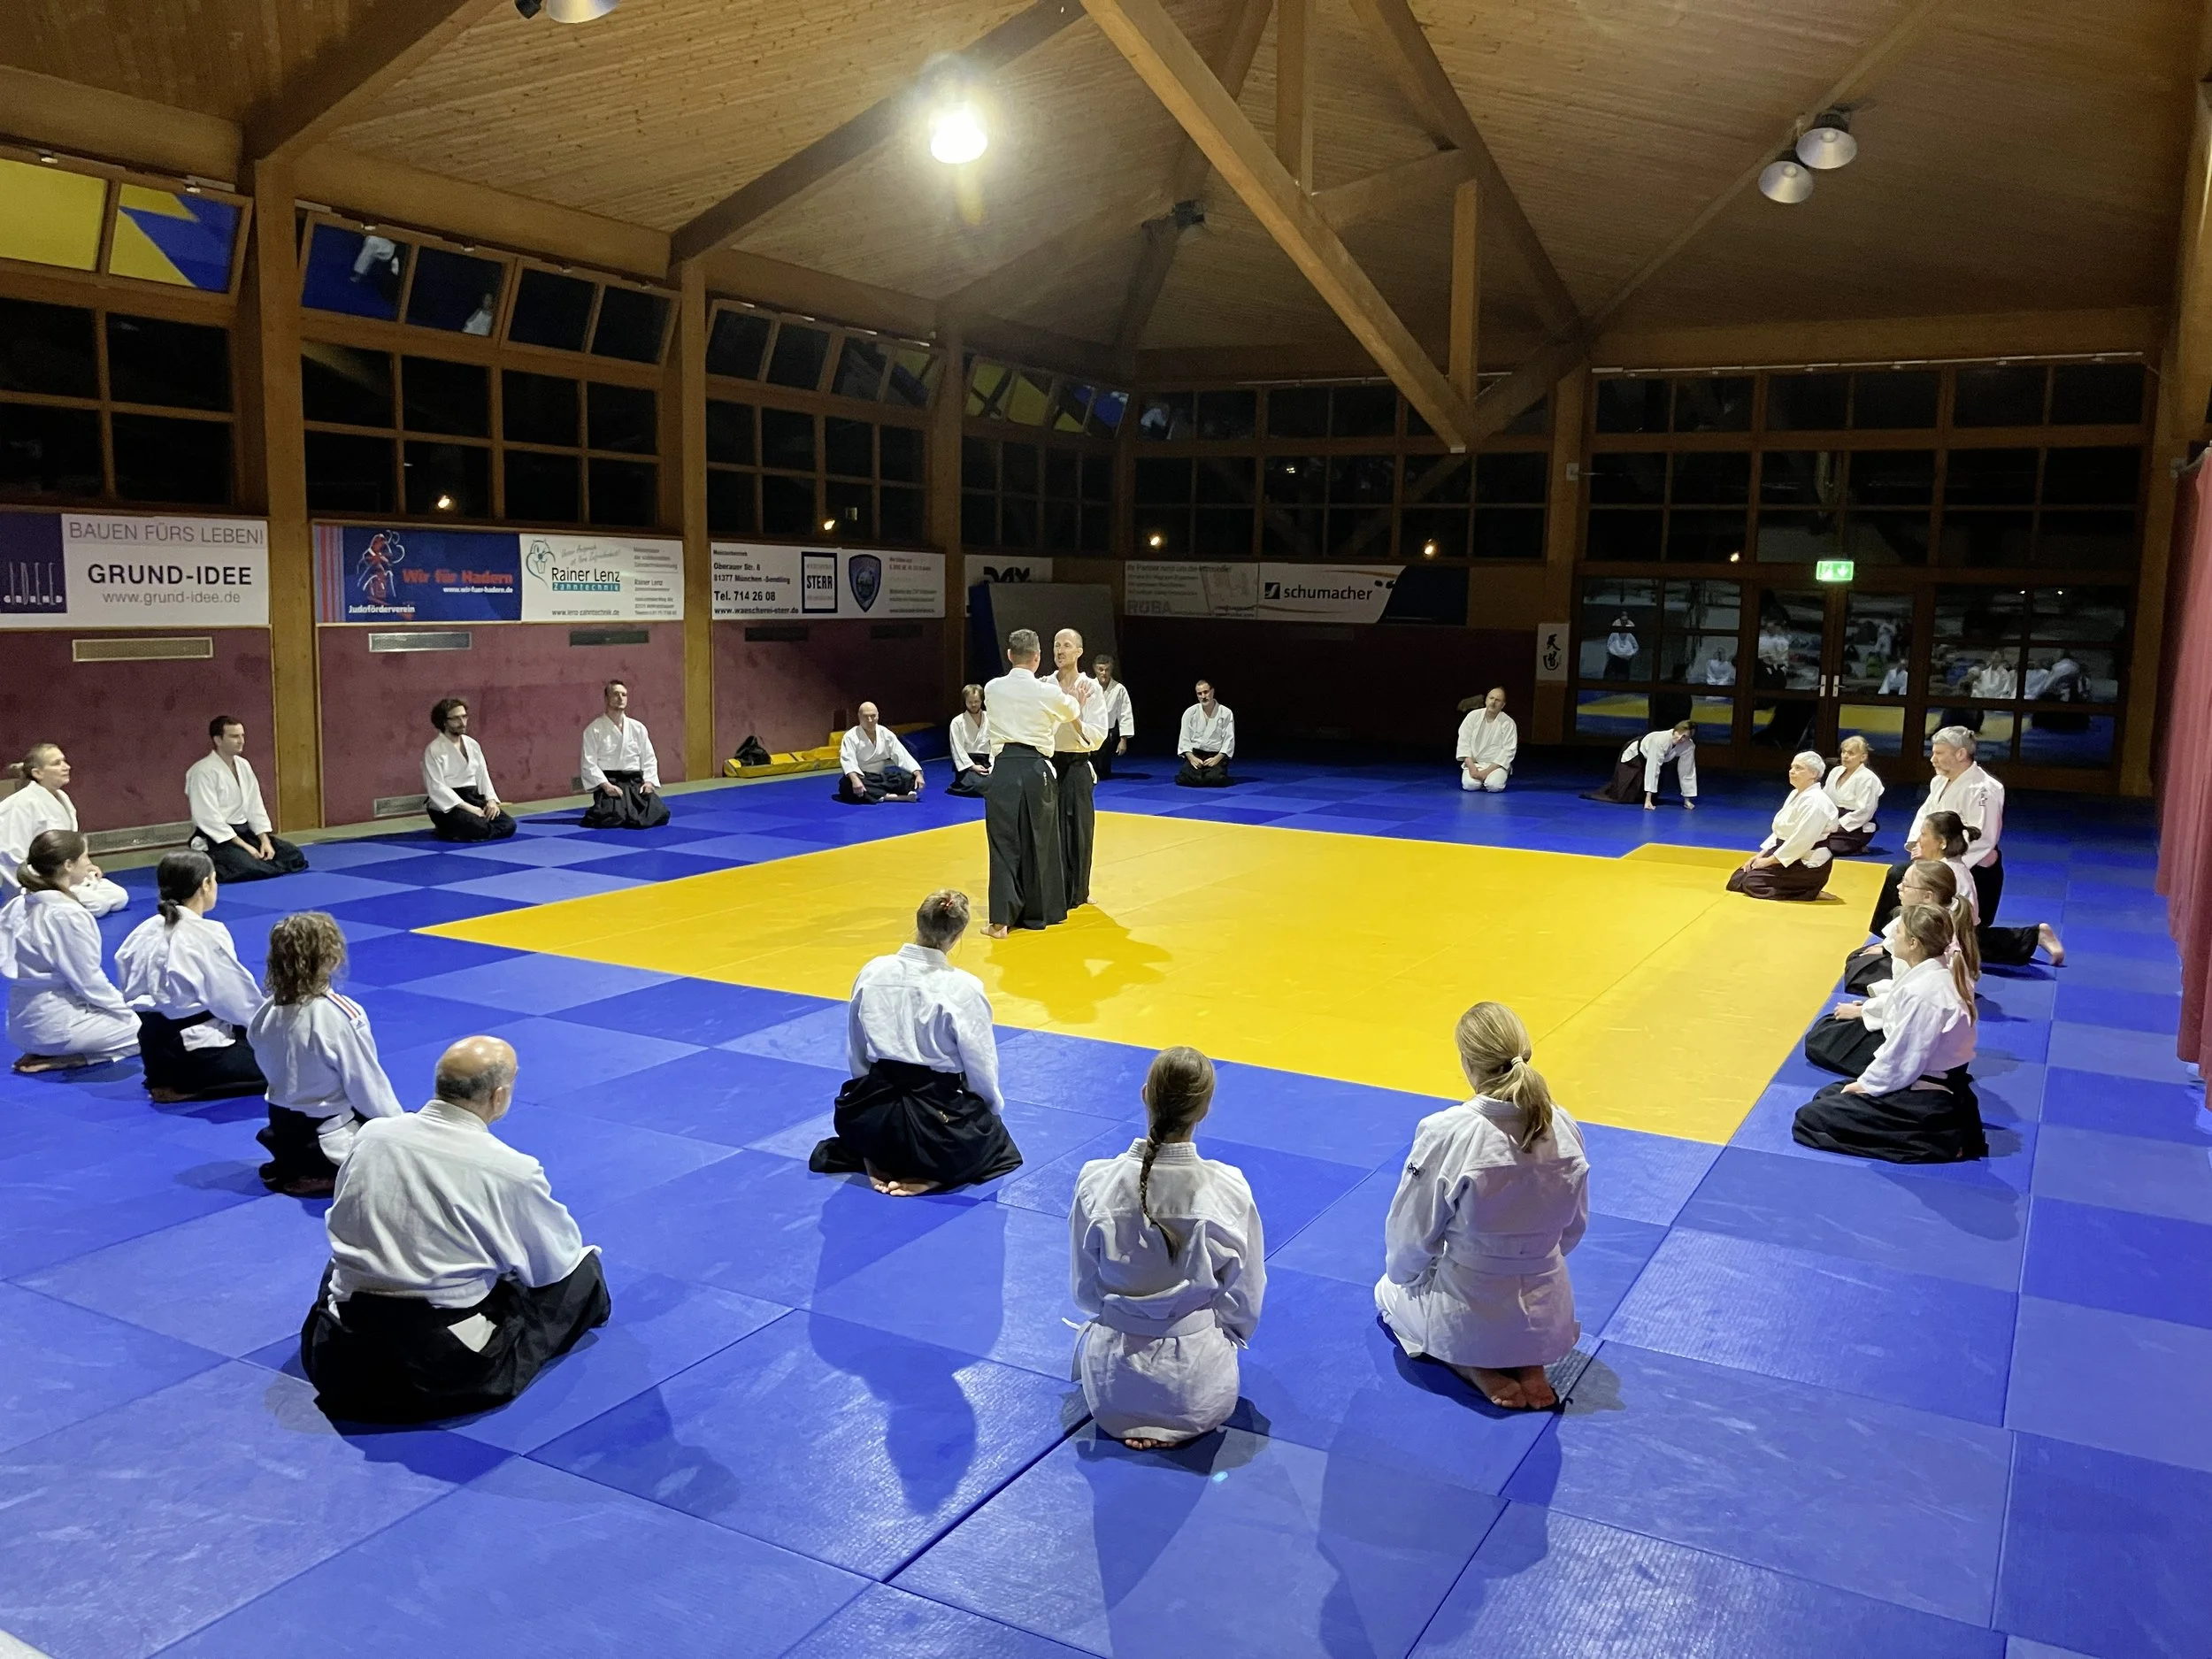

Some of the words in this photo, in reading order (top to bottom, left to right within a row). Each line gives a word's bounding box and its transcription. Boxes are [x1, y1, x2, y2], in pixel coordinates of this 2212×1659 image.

[69, 521, 137, 541] BAUEN
[144, 522, 195, 542] FÜRS
[201, 526, 264, 544] LEBEN!
[88, 563, 252, 586] GRUND-IDEE
[551, 566, 590, 582] Rainer
[595, 567, 620, 582] Lenz
[713, 562, 742, 572] Oberauer
[403, 568, 430, 584] Wir
[435, 569, 457, 584] für
[734, 574, 762, 583] München
[806, 574, 833, 589] STERR
[553, 581, 620, 592] Zahntechnik
[1283, 584, 1373, 600] schumacher
[103, 590, 241, 607] www.grund-idee.de
[713, 590, 731, 602] Tel.
[733, 590, 749, 602] 714
[752, 590, 763, 602] 26
[765, 590, 776, 602] 08
[349, 603, 416, 615] Judoförderverein
[713, 606, 800, 615] www.waescherei-sterr.de
